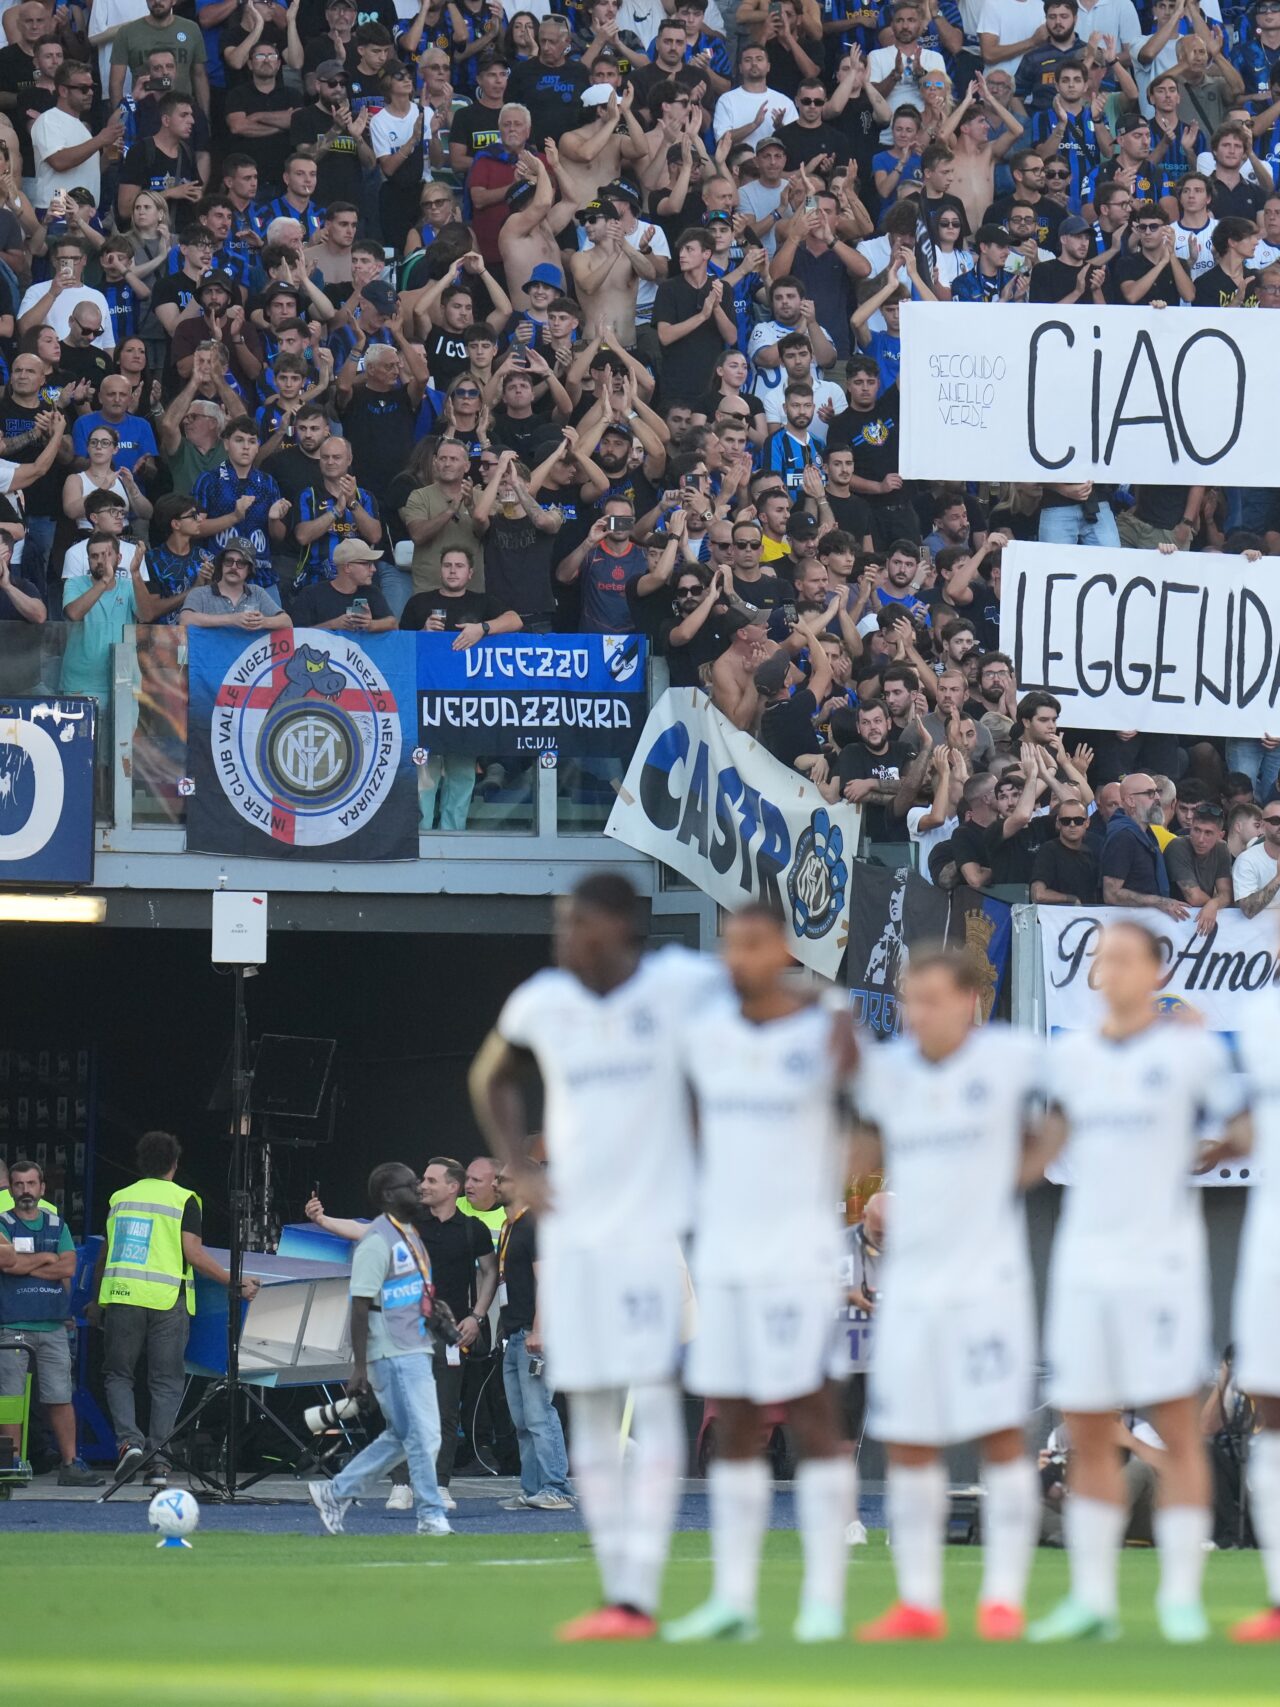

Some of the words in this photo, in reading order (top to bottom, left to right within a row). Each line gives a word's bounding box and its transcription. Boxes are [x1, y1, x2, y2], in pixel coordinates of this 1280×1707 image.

[929, 354, 1006, 380] SECONDO
[938, 382, 994, 405] ANELLO
[939, 405, 991, 428] VERDE
[233, 639, 290, 684] VIGEZZO
[346, 648, 387, 712] VIGEZZO
[219, 685, 240, 743] VALLE
[423, 696, 631, 728] NEROAZZURRA
[219, 752, 245, 796] CLUB
[338, 717, 393, 827] NERAZZURRA
